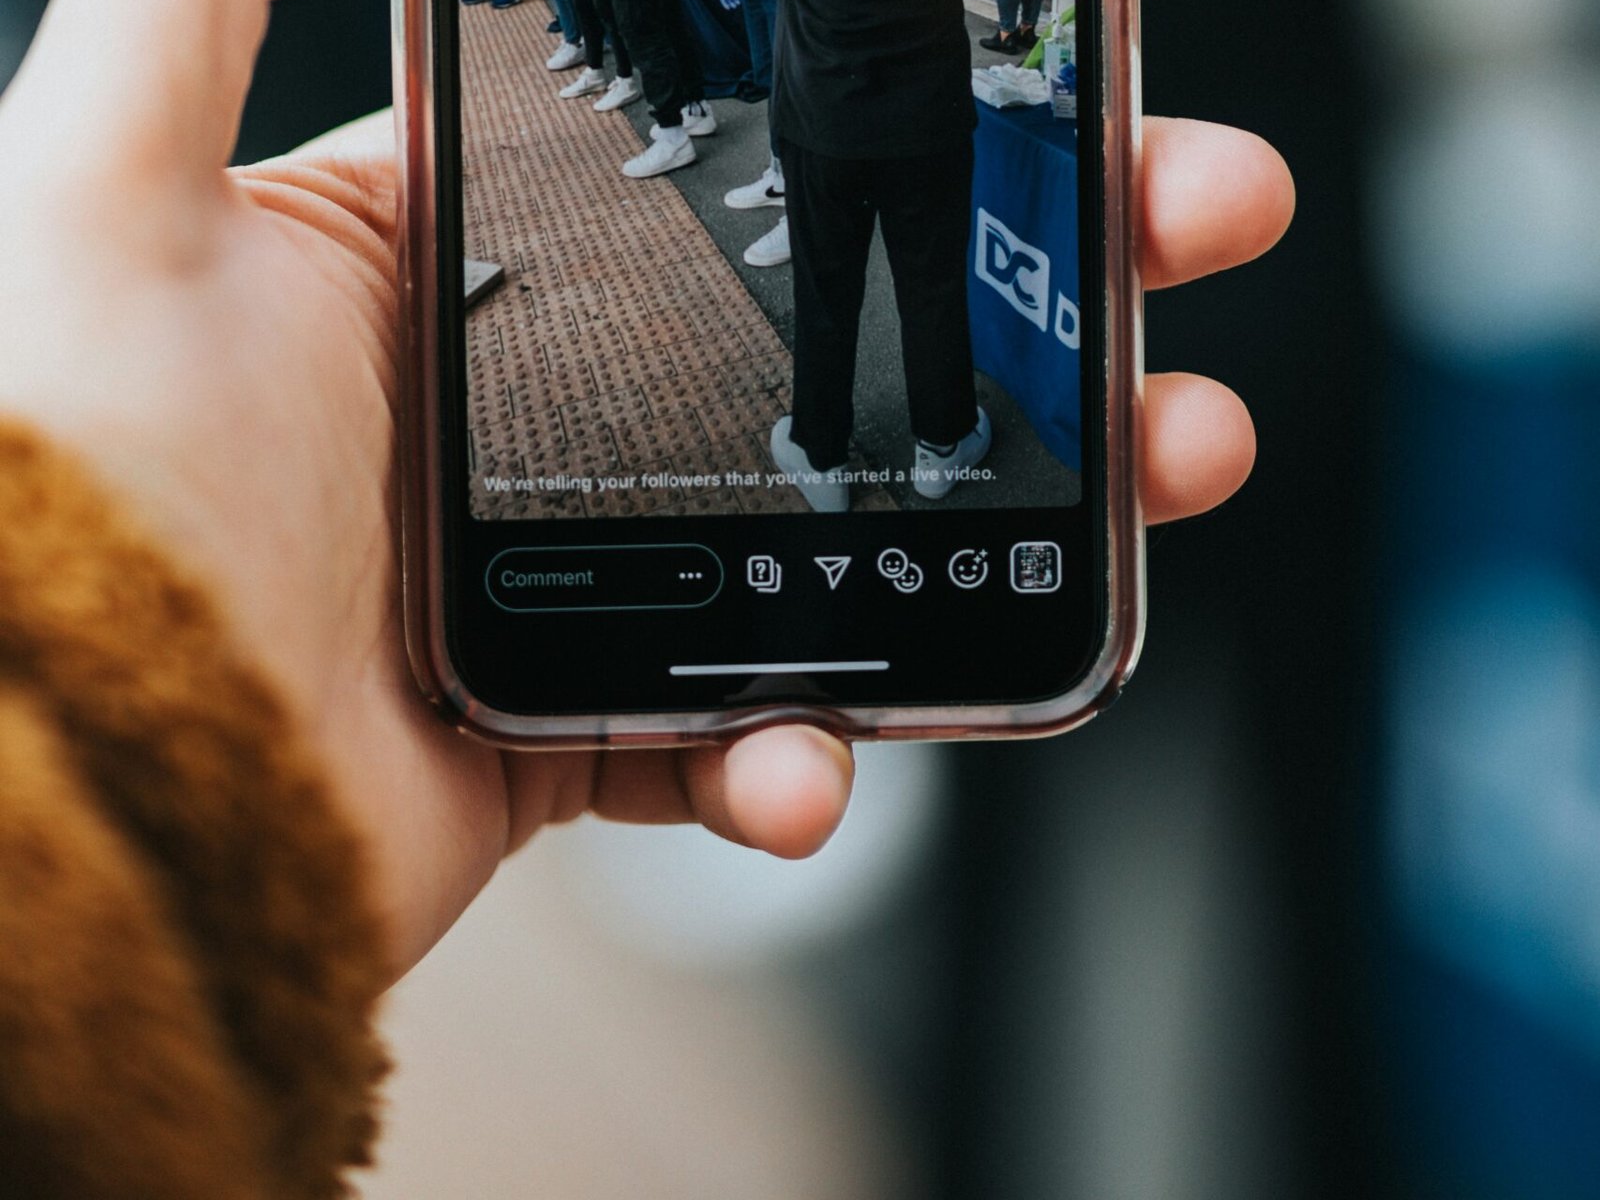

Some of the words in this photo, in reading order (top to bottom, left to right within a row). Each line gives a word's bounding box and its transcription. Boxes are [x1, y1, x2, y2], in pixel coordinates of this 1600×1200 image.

[484, 476, 534, 491] We're
[538, 474, 592, 493] telling
[597, 476, 637, 492] your
[641, 472, 721, 488] followers
[725, 470, 760, 486] that
[766, 471, 822, 488] you've
[826, 467, 890, 483] started
[895, 470, 905, 482] a
[910, 467, 940, 481] live
[944, 465, 997, 481] video.
[500, 569, 594, 587] Comment
